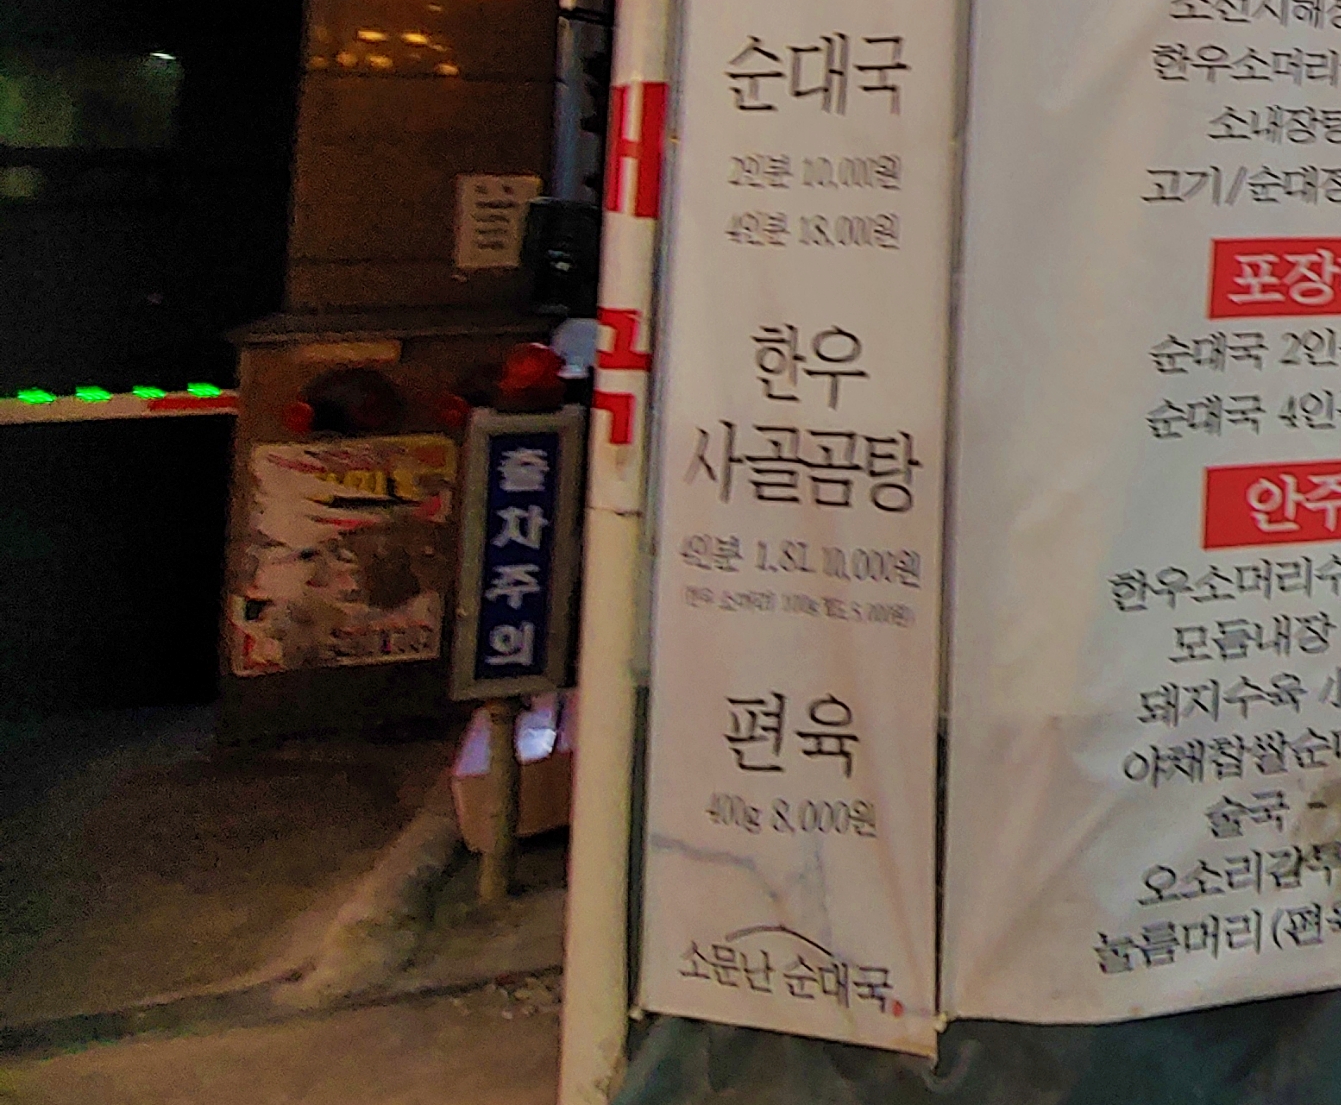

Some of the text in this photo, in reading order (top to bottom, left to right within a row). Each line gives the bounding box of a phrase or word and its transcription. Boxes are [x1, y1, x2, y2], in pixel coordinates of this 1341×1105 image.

[725, 31, 912, 116] 순대국
[752, 324, 870, 410] 한우
[1149, 330, 1269, 375] 순대국
[1146, 393, 1265, 440] 순대국
[683, 420, 923, 512] 사골곰탕
[725, 691, 860, 778] 편육
[1137, 672, 1306, 728] 돼지수육
[679, 938, 893, 1014] 소문난 순대국
